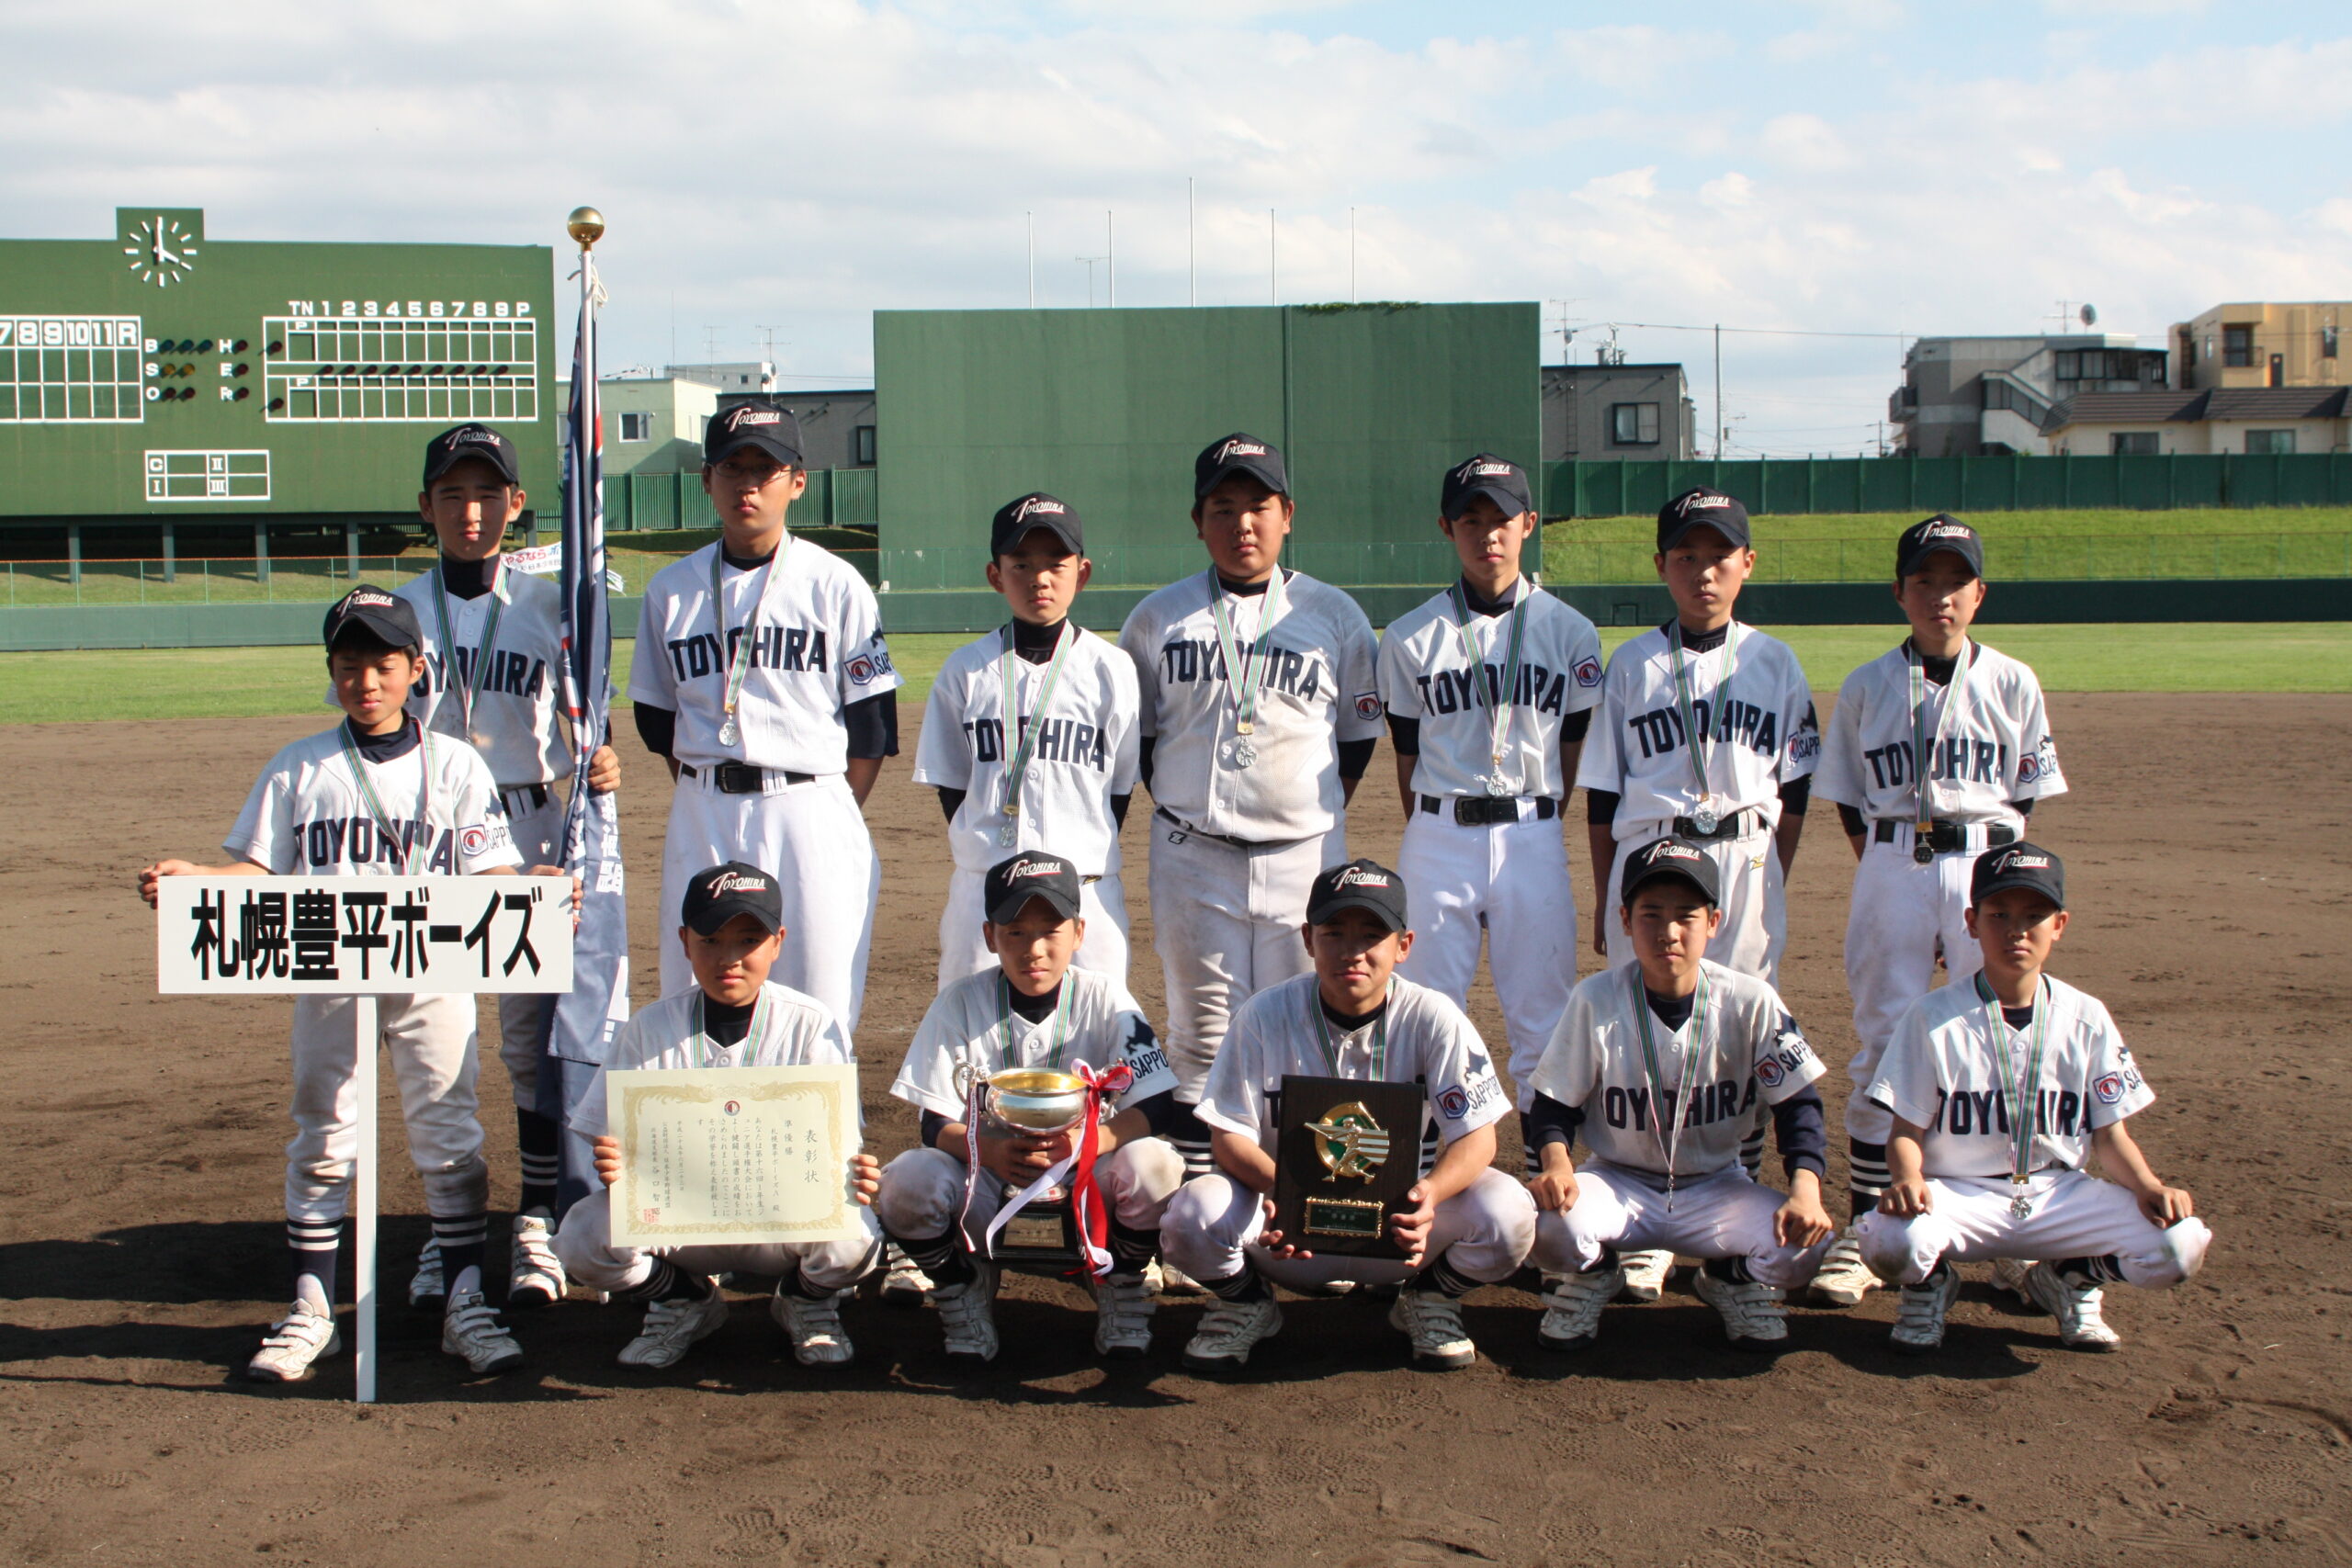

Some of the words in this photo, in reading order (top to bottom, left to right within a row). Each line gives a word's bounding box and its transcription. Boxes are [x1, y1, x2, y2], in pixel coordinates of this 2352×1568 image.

[288, 300, 313, 316] TN
[322, 301, 330, 317] 1
[342, 301, 356, 317] 2
[364, 301, 378, 317] 3
[386, 301, 400, 317] 4
[408, 301, 422, 317] 5
[430, 301, 444, 317] 6
[451, 301, 465, 317] 7
[473, 301, 487, 317] 8
[495, 301, 509, 317] 9
[516, 301, 530, 317] P
[18, 321, 38, 345] 8
[44, 321, 63, 345] 9
[67, 321, 89, 345] 10
[92, 321, 114, 345] 11
[119, 321, 137, 345] R
[295, 321, 308, 330] P
[144, 338, 159, 353] B
[219, 338, 232, 354] H
[145, 363, 159, 377] S
[220, 362, 232, 377] E
[296, 378, 309, 387] P
[145, 387, 160, 400] O
[149, 457, 164, 472] C
[190, 886, 543, 980] 札幌豊平ボーイズ
[804, 1129, 820, 1183] 表彰状
